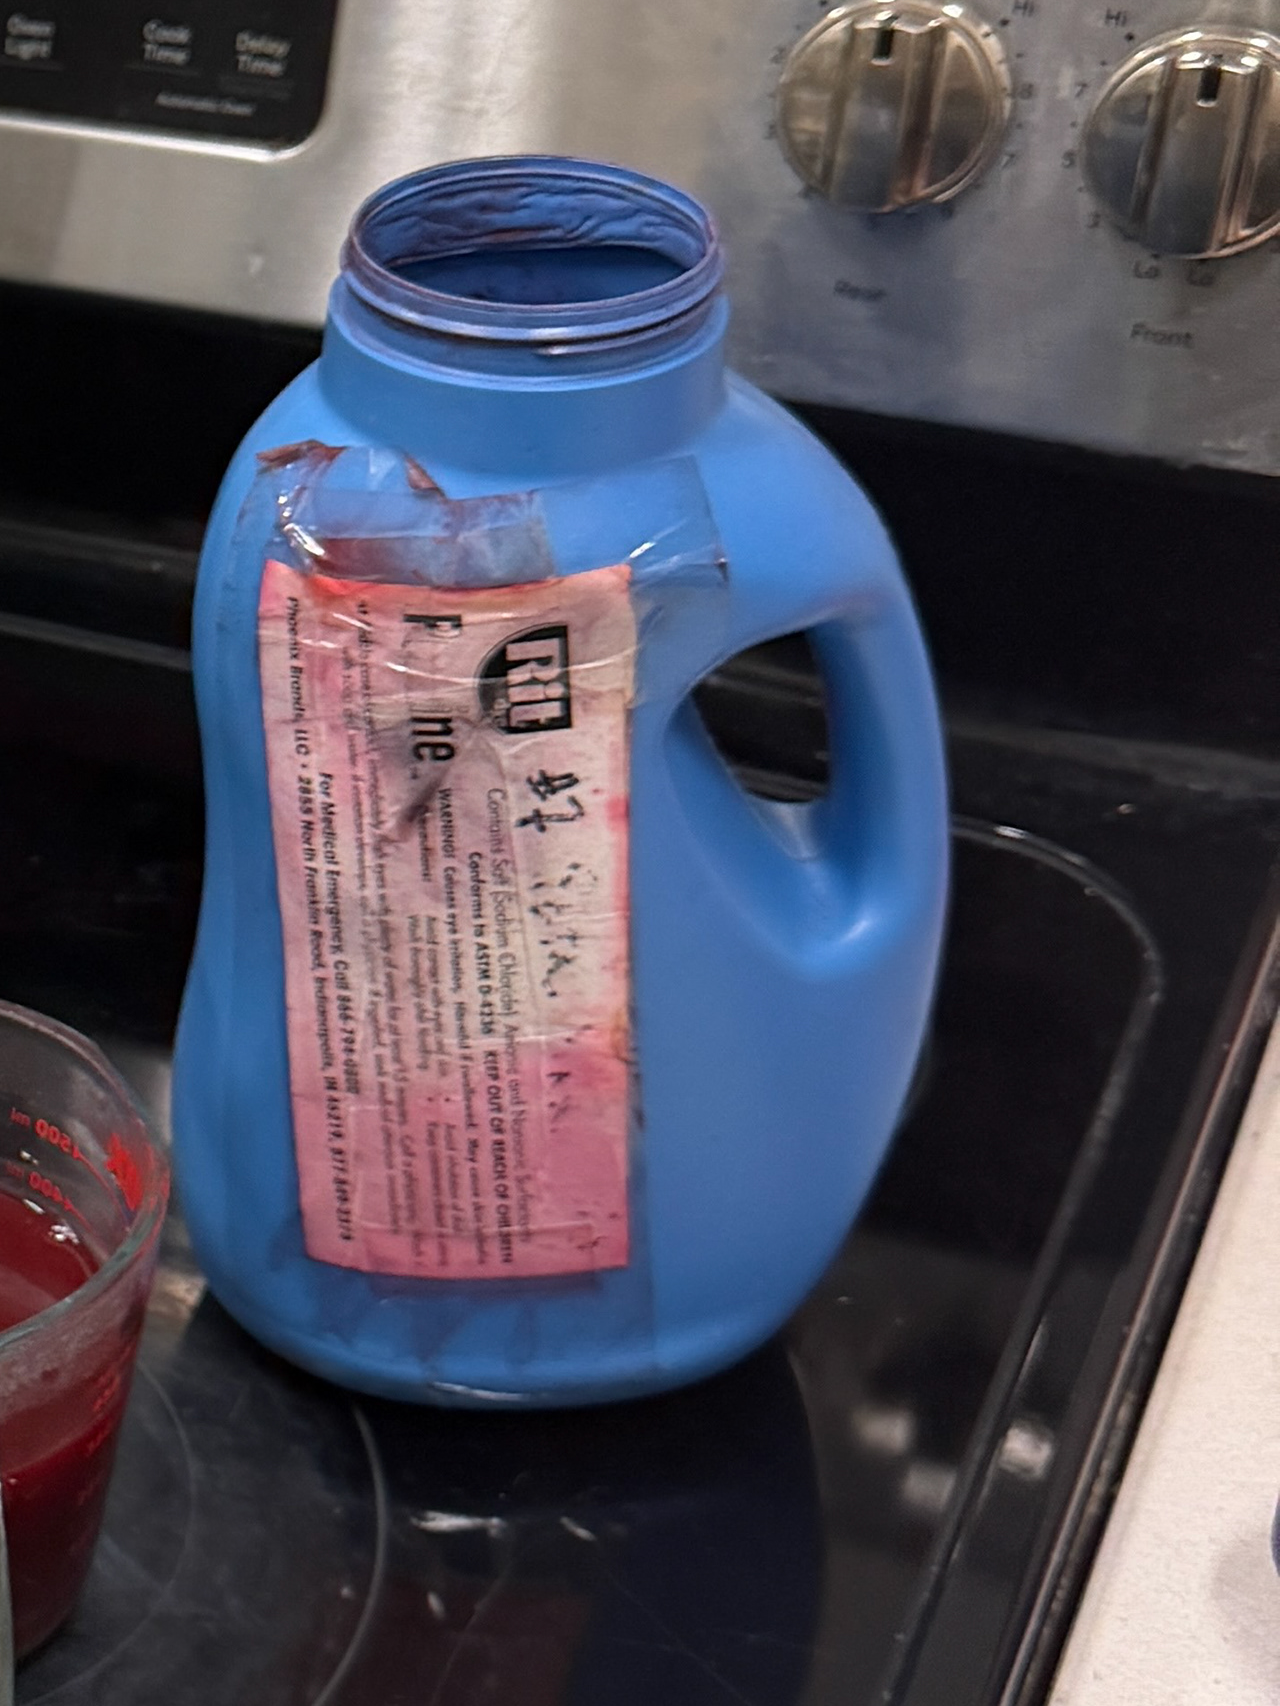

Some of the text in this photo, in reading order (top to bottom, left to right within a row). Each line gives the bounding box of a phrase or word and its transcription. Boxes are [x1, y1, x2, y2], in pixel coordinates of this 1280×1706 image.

[142, 18, 191, 44] Cook
[1104, 7, 1128, 28] Hi
[143, 42, 190, 65] Time
[235, 29, 292, 57] Delay
[236, 54, 288, 78] Time
[287, 596, 303, 661] Phoenix
[506, 638, 563, 729] Rit
[293, 729, 311, 757] LLC
[319, 772, 335, 798] For
[321, 802, 340, 866] Medical
[437, 787, 456, 860] WARNING!
[486, 788, 510, 854] Contains
[301, 820, 317, 863] North
[442, 866, 458, 909] Causes
[491, 858, 512, 886] Salt
[304, 865, 323, 925] Franklin
[444, 912, 460, 936] eye
[489, 891, 521, 948] (Sodium
[309, 928, 327, 971] Road,
[333, 959, 351, 992] Call
[496, 952, 521, 1016] Chloride)
[453, 1001, 473, 1050] Harmful
[468, 852, 514, 1265] Conforms to ASTM D-4236 KEEP OUT OF REACH OF CHILDREN
[324, 1075, 339, 1092] IN
[508, 1079, 527, 1105] and
[464, 1138, 480, 1163] May
